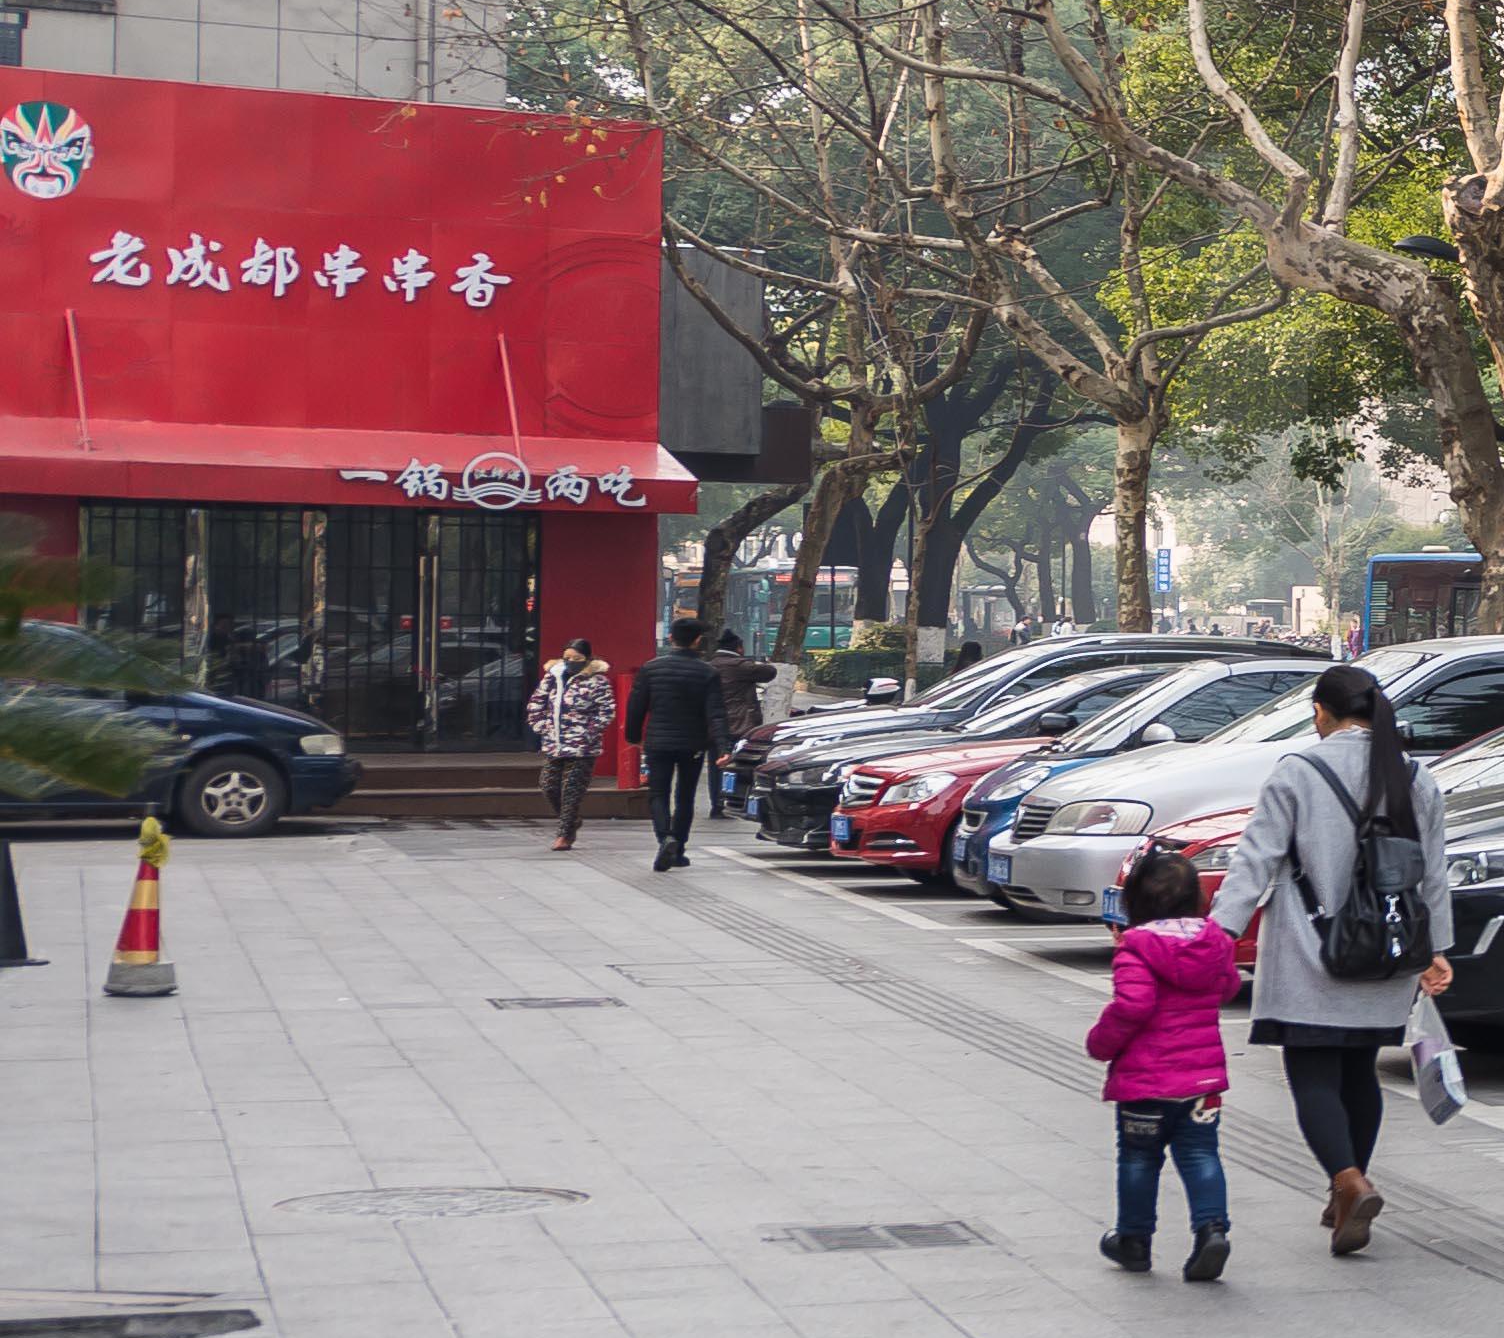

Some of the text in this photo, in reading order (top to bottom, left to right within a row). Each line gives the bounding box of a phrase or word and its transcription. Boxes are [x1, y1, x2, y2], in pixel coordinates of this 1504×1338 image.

[90, 230, 512, 308] 老成都串串香
[339, 458, 648, 507] 一锅 两吃
